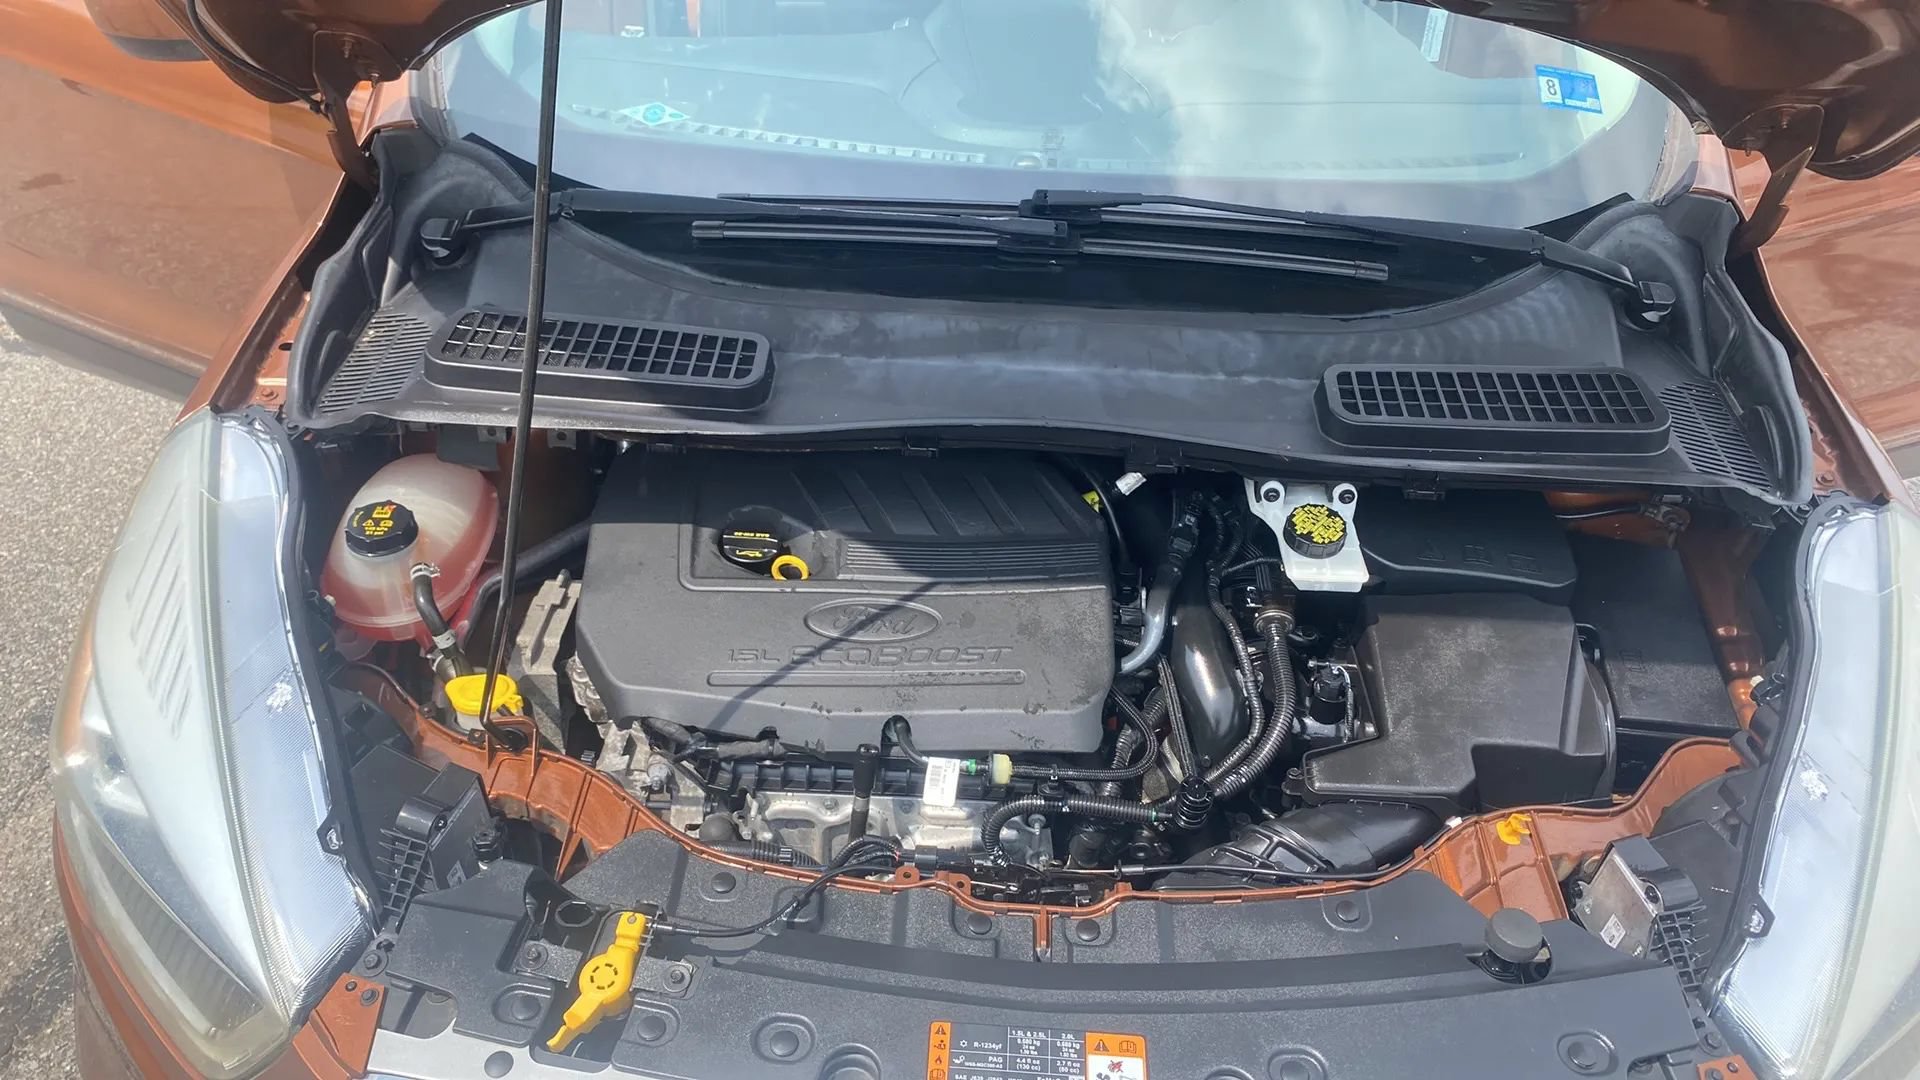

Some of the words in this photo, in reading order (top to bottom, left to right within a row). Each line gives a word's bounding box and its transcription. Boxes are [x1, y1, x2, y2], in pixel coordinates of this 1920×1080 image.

[1546, 79, 1557, 96] 8
[832, 606, 920, 635] Ford
[974, 1042, 1002, 1050] R-1234yf
